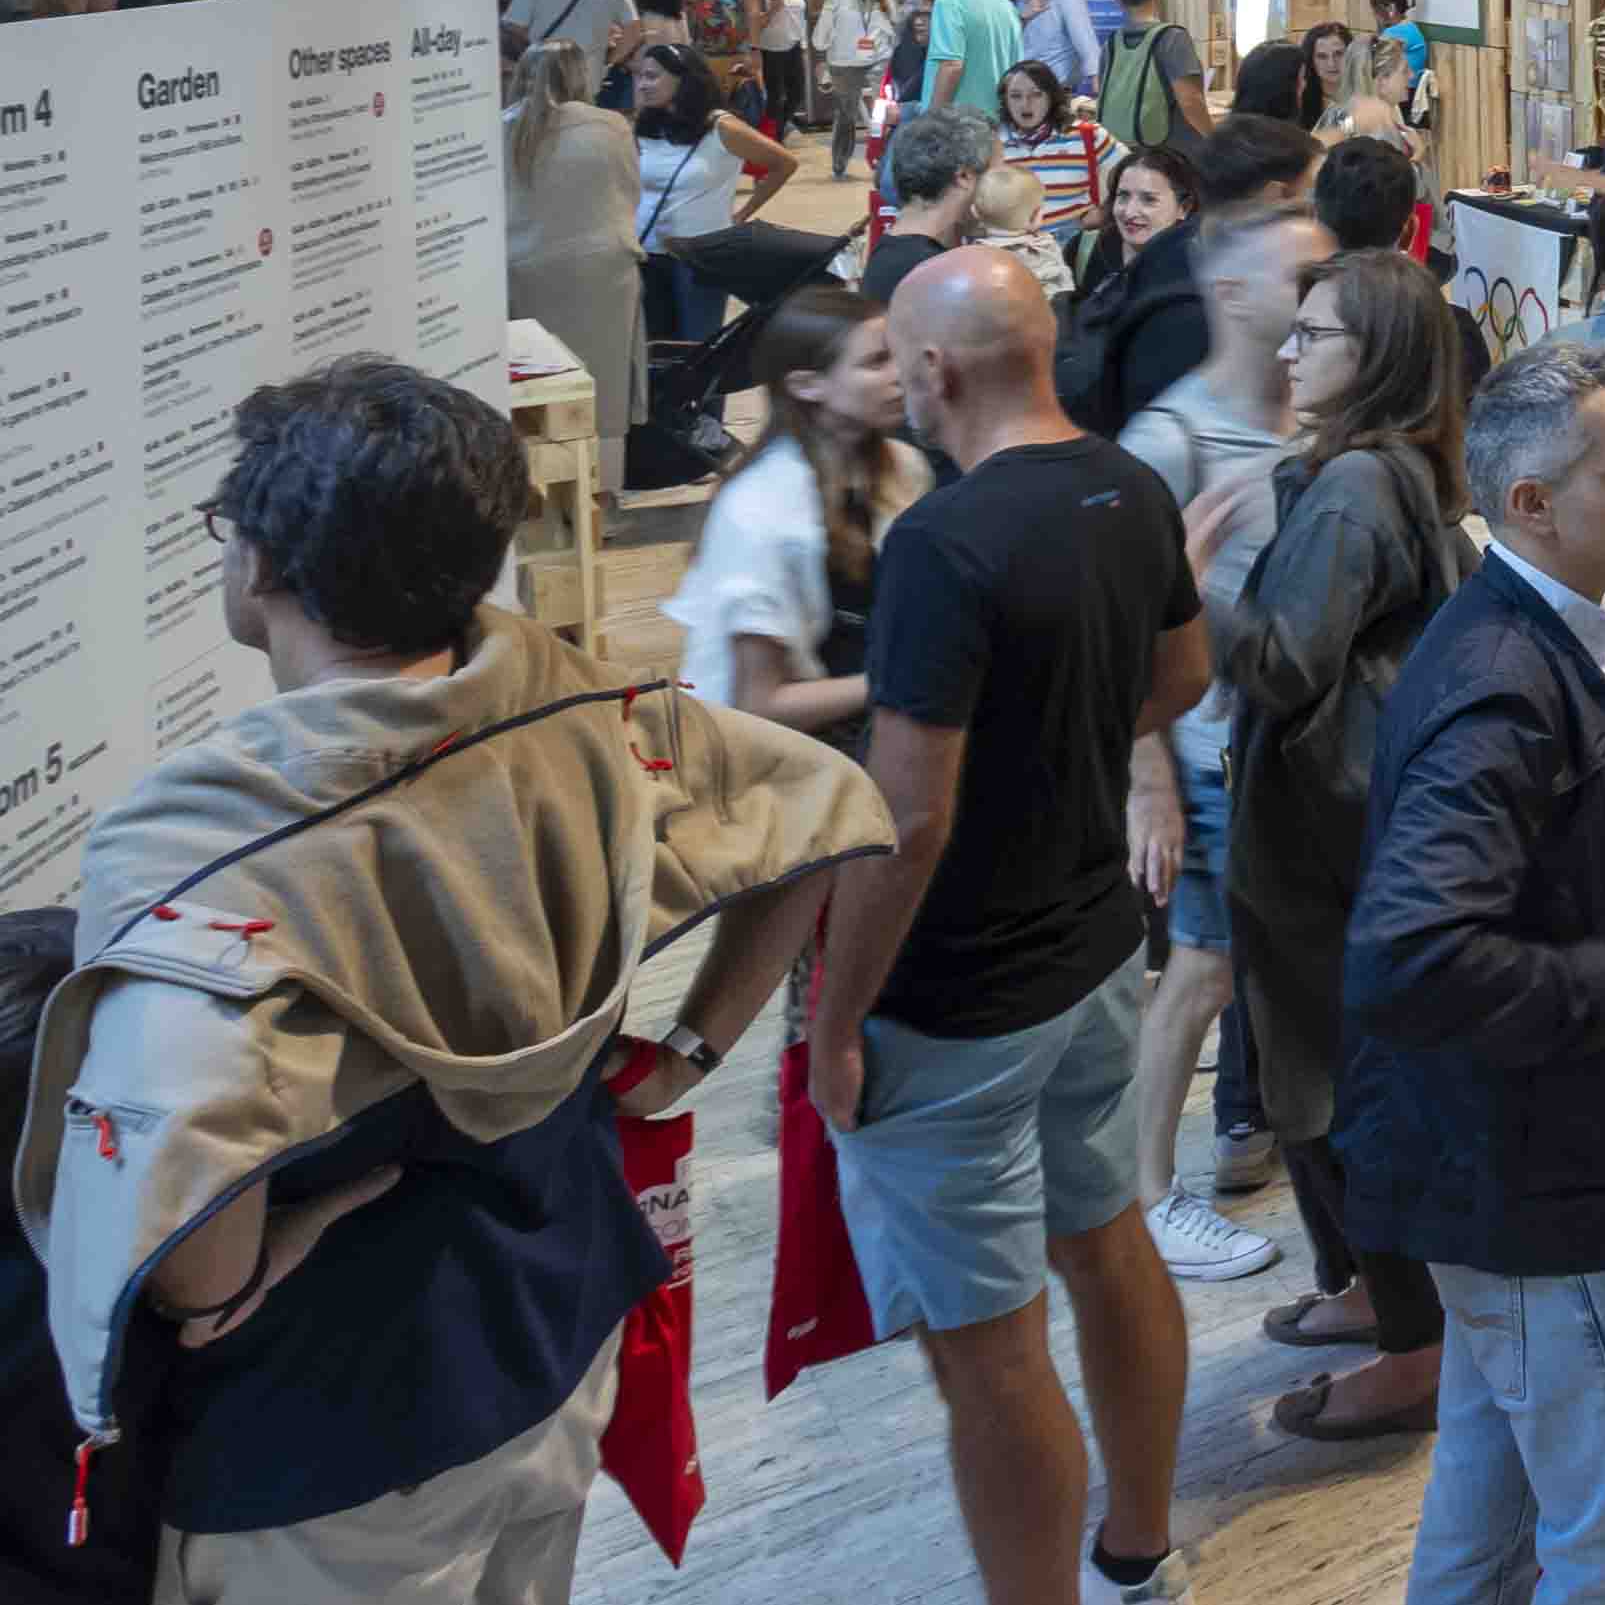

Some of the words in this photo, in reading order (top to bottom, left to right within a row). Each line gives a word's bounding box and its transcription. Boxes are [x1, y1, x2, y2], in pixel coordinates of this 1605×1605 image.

[288, 46, 334, 79] Other
[336, 40, 391, 77] spaces
[411, 22, 462, 59] All-day
[138, 65, 219, 110] Garden
[34, 88, 52, 128] 4
[46, 742, 62, 785] 5
